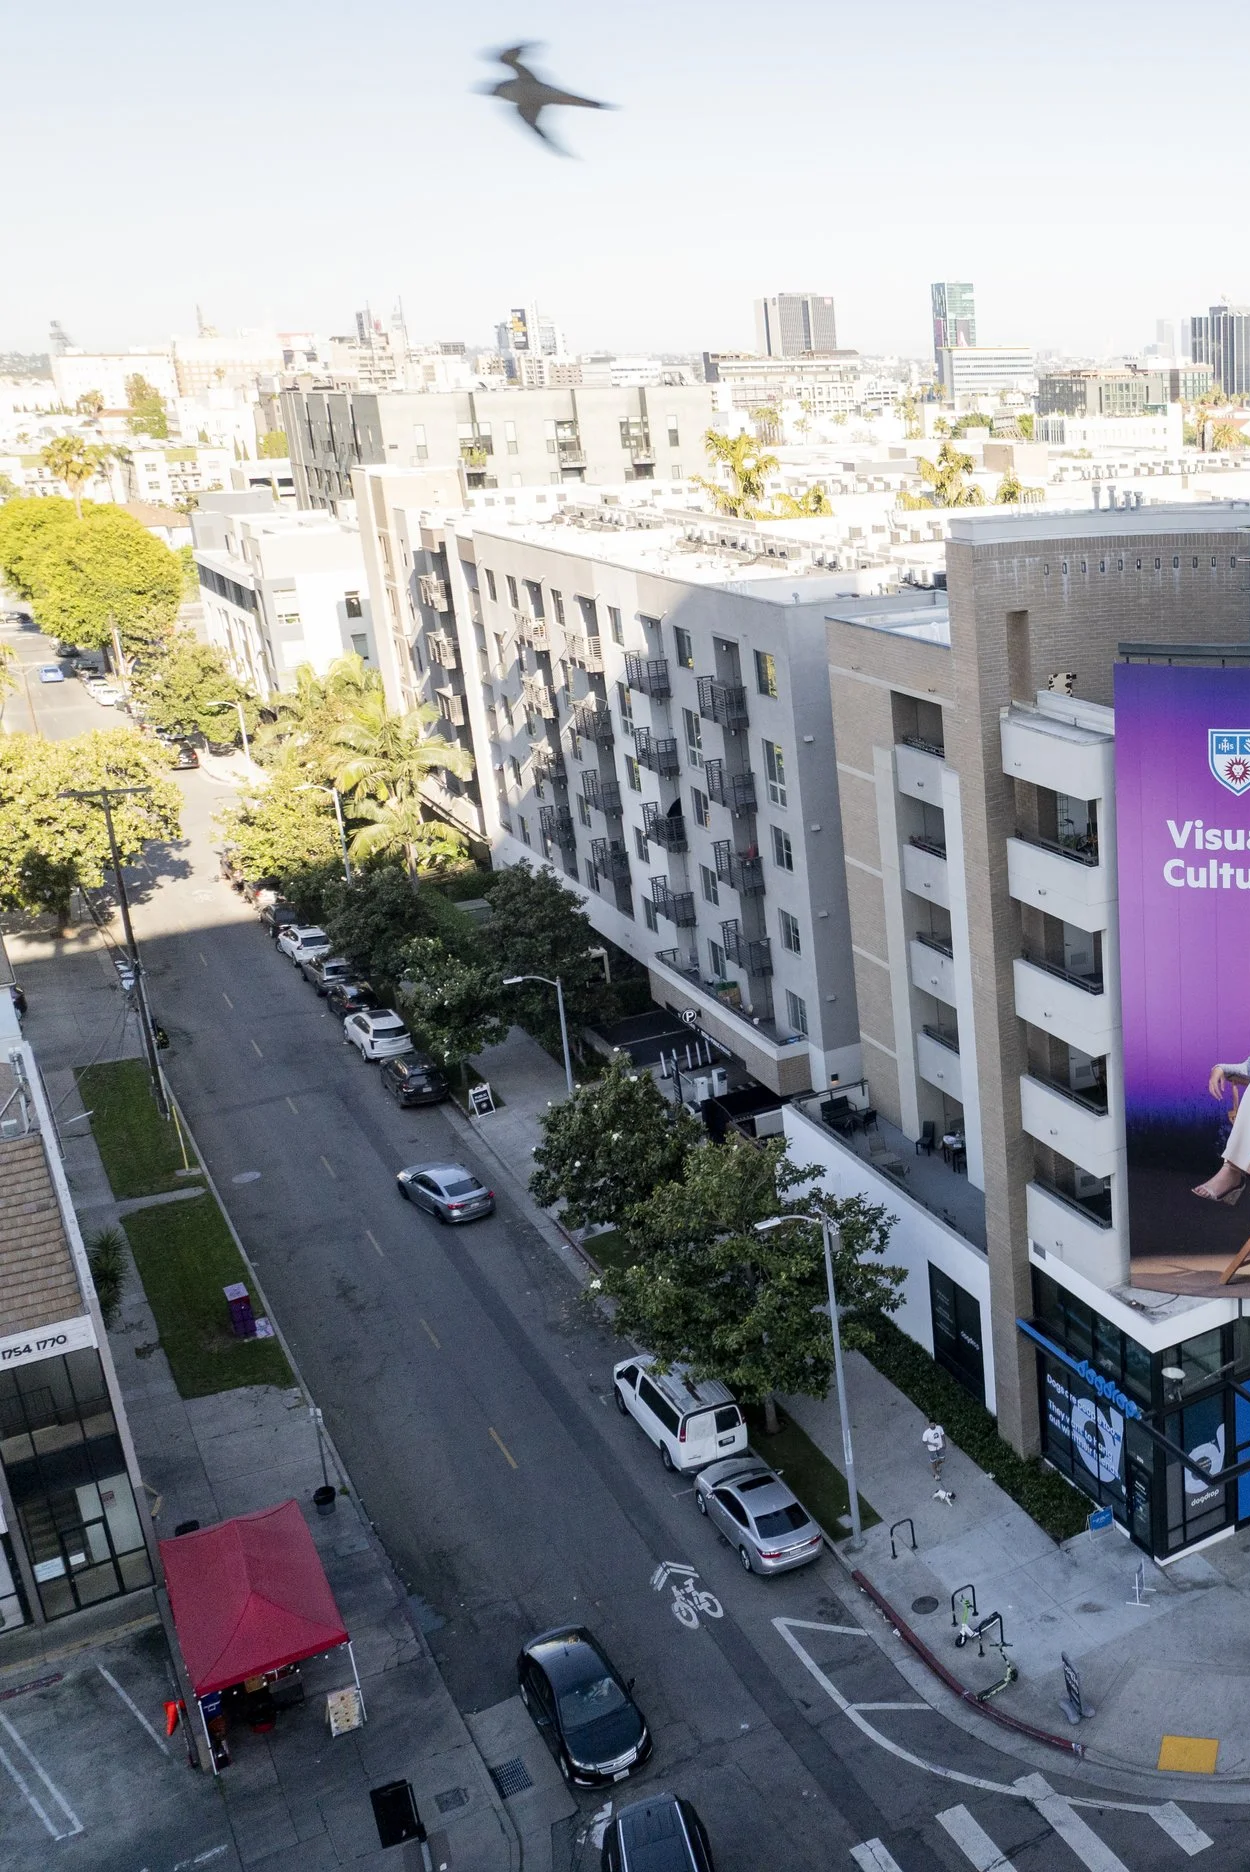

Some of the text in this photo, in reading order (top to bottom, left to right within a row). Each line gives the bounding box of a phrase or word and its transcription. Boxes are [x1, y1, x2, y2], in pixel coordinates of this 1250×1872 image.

[1, 1334, 67, 1360] 1754 1770
[1190, 1488, 1220, 1507] dogdrop
